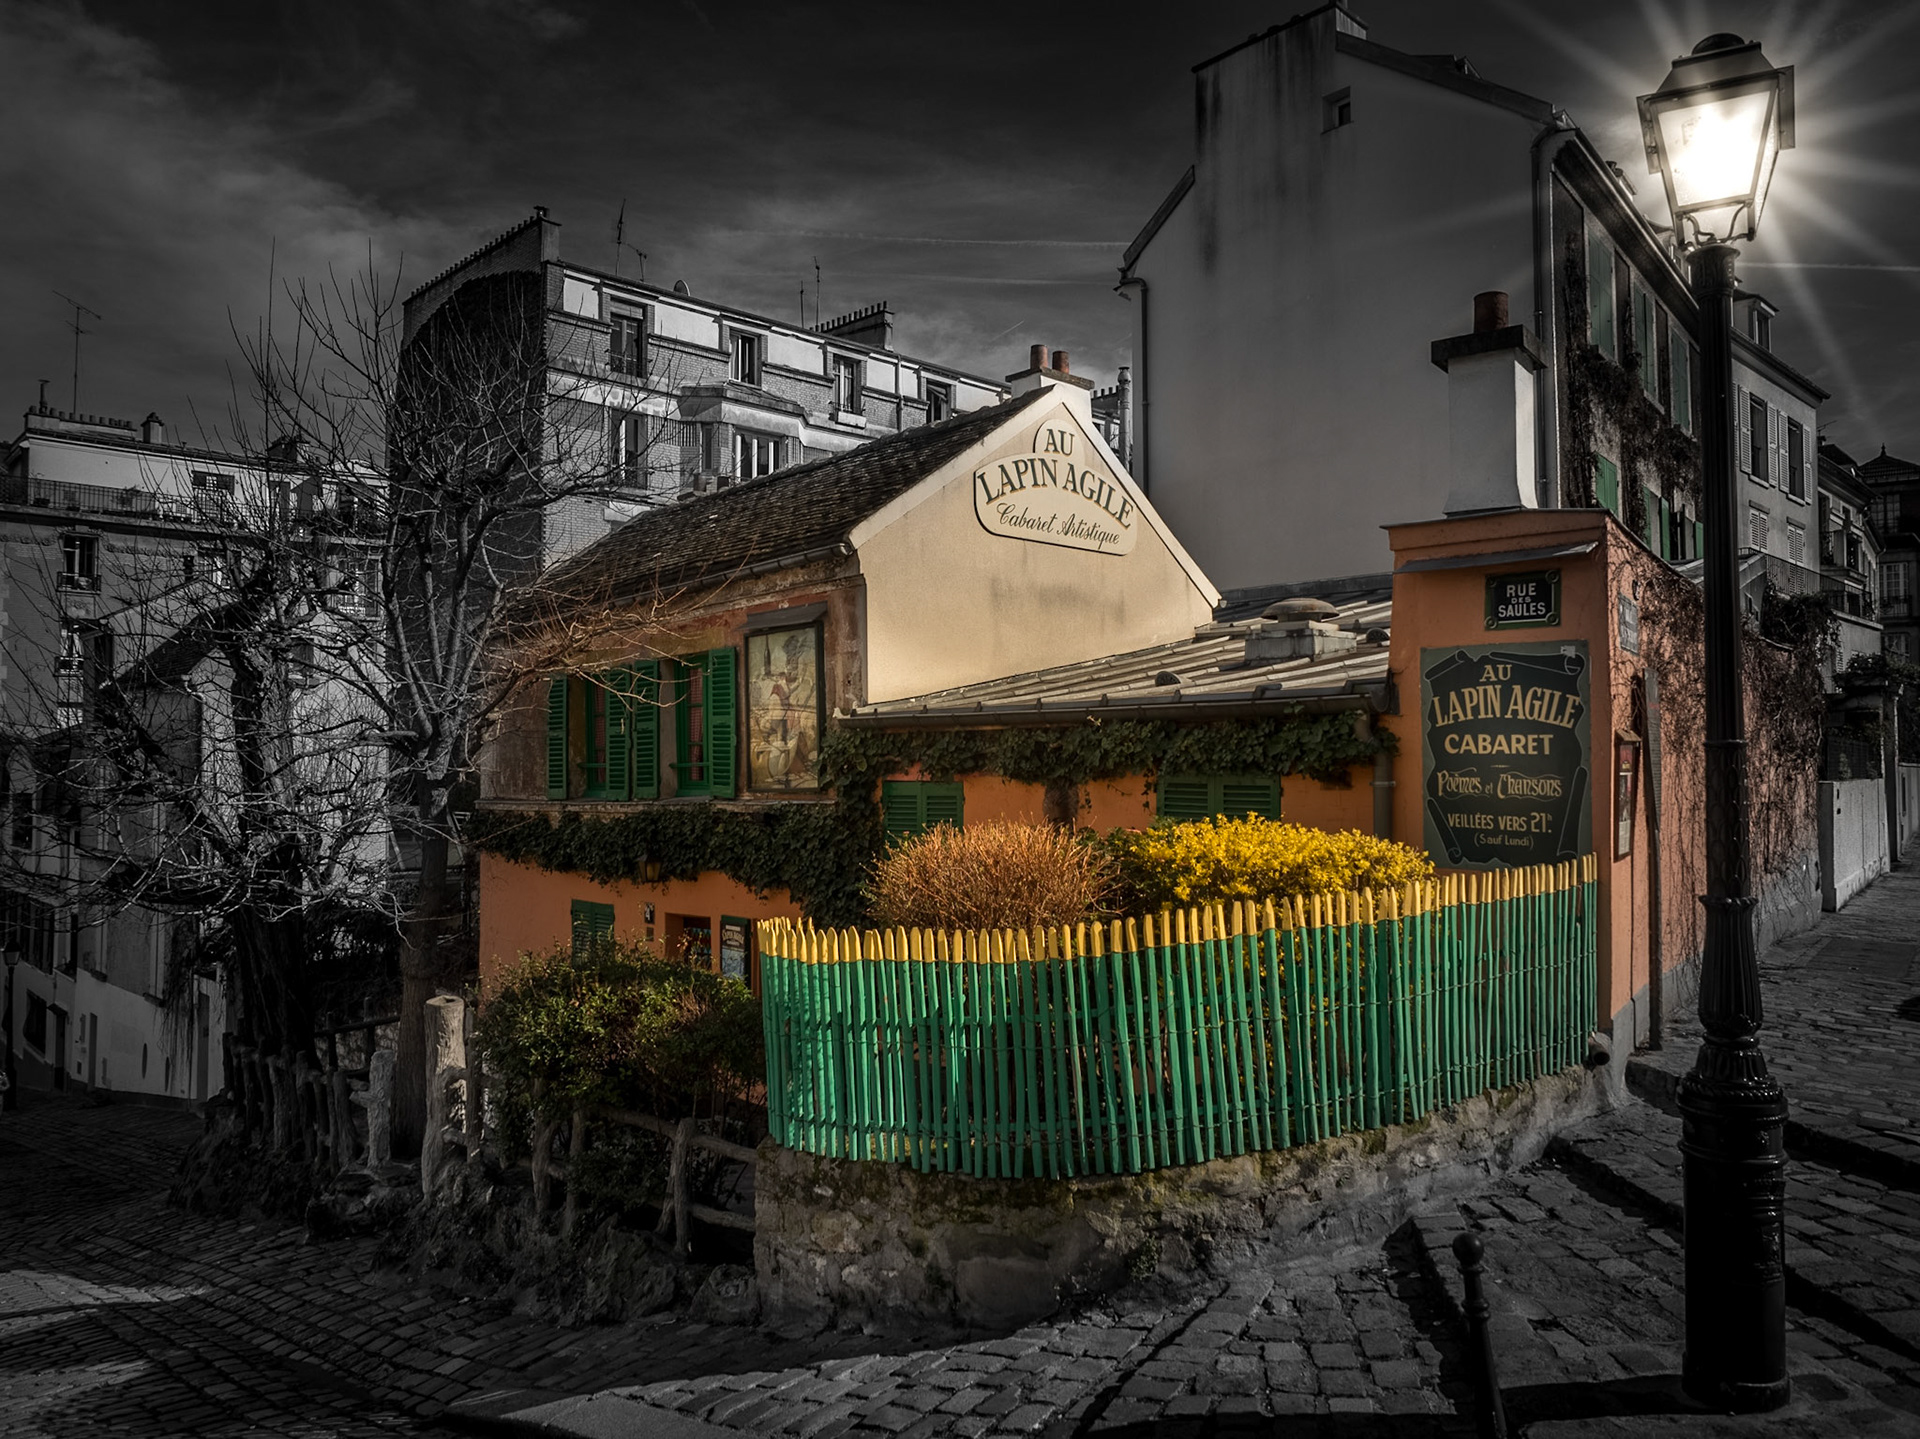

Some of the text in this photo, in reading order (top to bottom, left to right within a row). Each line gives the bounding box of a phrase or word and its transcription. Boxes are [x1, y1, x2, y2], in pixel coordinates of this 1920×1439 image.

[1044, 428, 1075, 456] AU
[977, 458, 1134, 529] LAPIN AGILE
[997, 502, 1120, 549] Cabaret Artistique
[1506, 582, 1537, 598] RUE
[1511, 596, 1532, 604] DES
[1498, 602, 1546, 618] SAULES
[1479, 664, 1512, 683] AU
[1433, 685, 1581, 729] LAPIN AGILE
[1444, 734, 1553, 755] CABARET
[1437, 769, 1563, 799] Poèmes et Chansons
[1447, 812, 1494, 830] VEILLÉES
[1498, 815, 1528, 832] VERS
